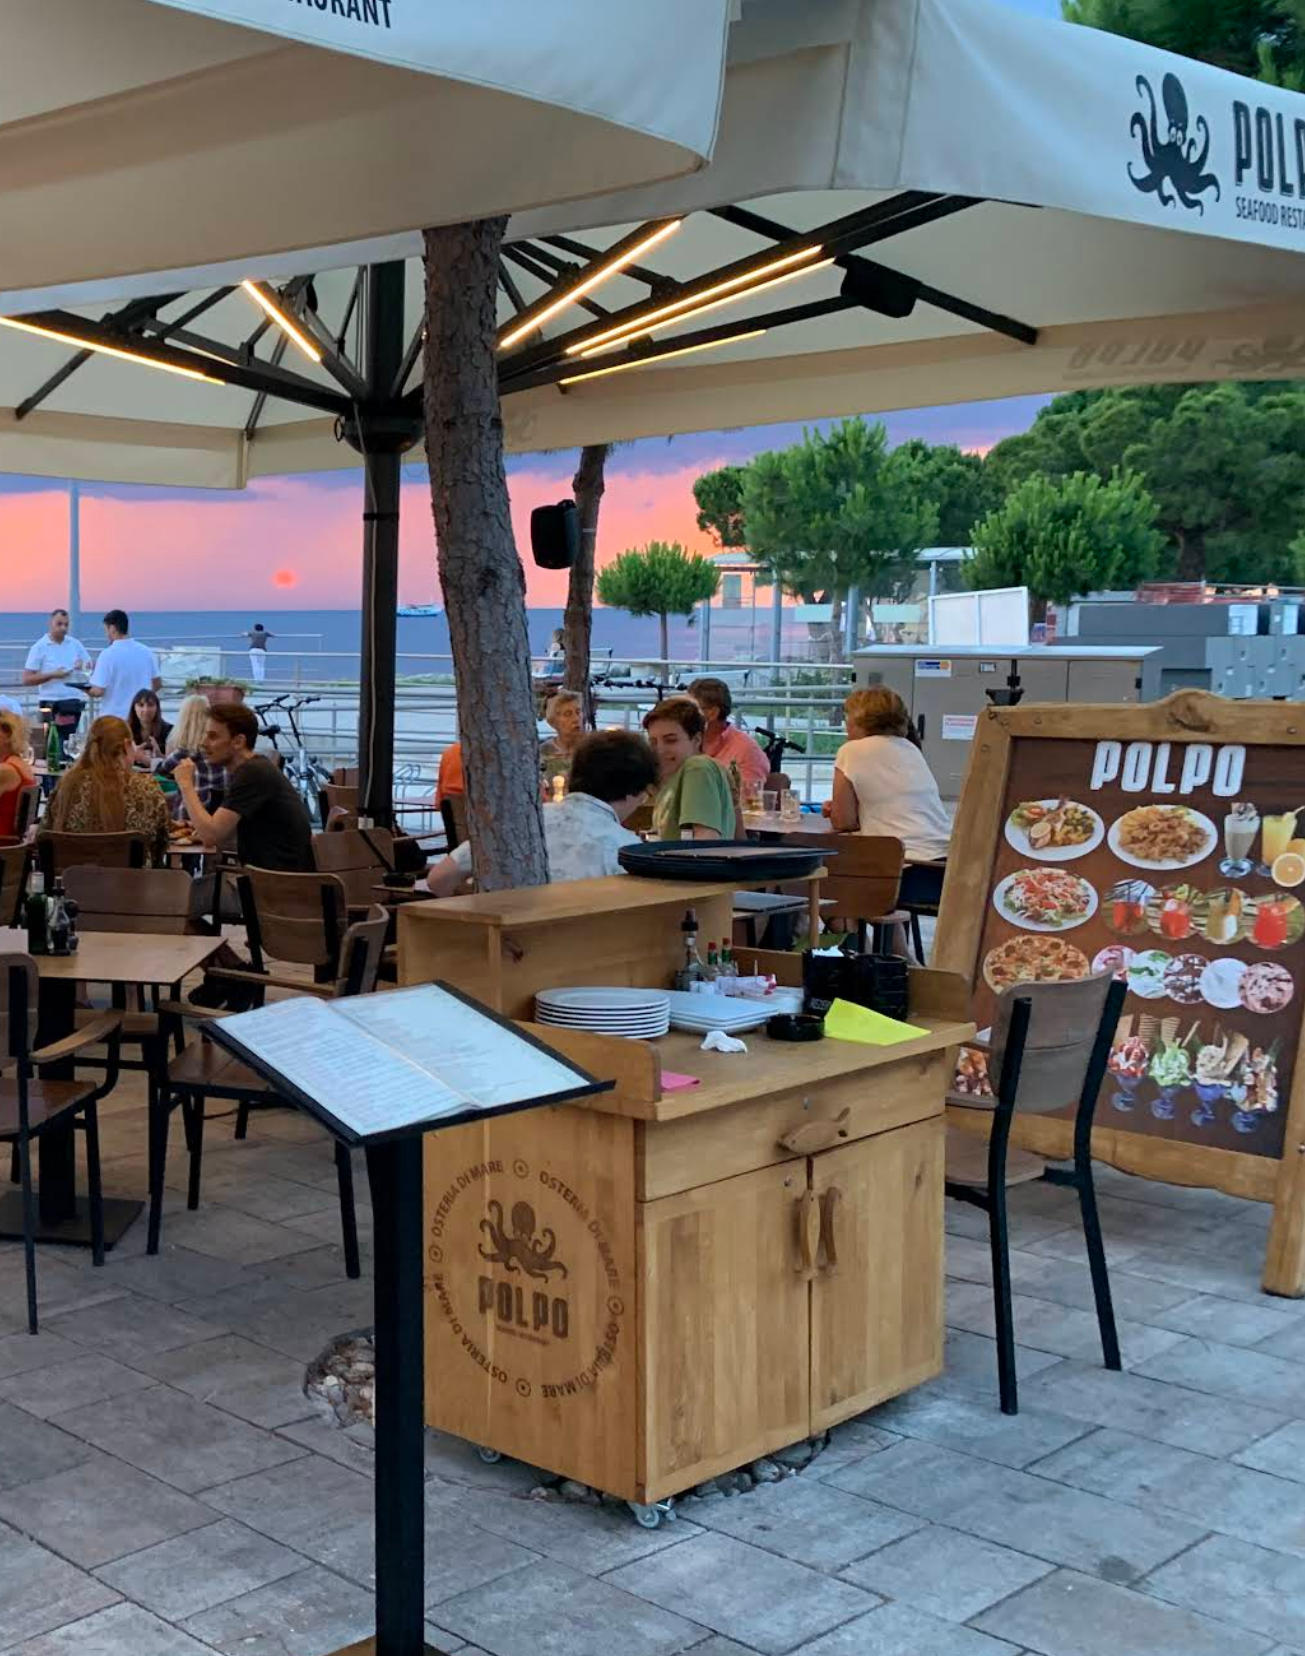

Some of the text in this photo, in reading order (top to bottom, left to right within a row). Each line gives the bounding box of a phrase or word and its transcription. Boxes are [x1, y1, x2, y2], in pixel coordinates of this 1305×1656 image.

[290, 0, 391, 28] RANT
[1235, 196, 1278, 225] SEAFOOD
[1090, 740, 1246, 797] POLPO
[431, 1160, 503, 1237] OSTERIA DI MARE
[540, 1170, 589, 1221] OSTERIA
[479, 1275, 569, 1339] POLPO
[462, 1334, 508, 1384] OSTERIA
[541, 1380, 577, 1398] MARE
